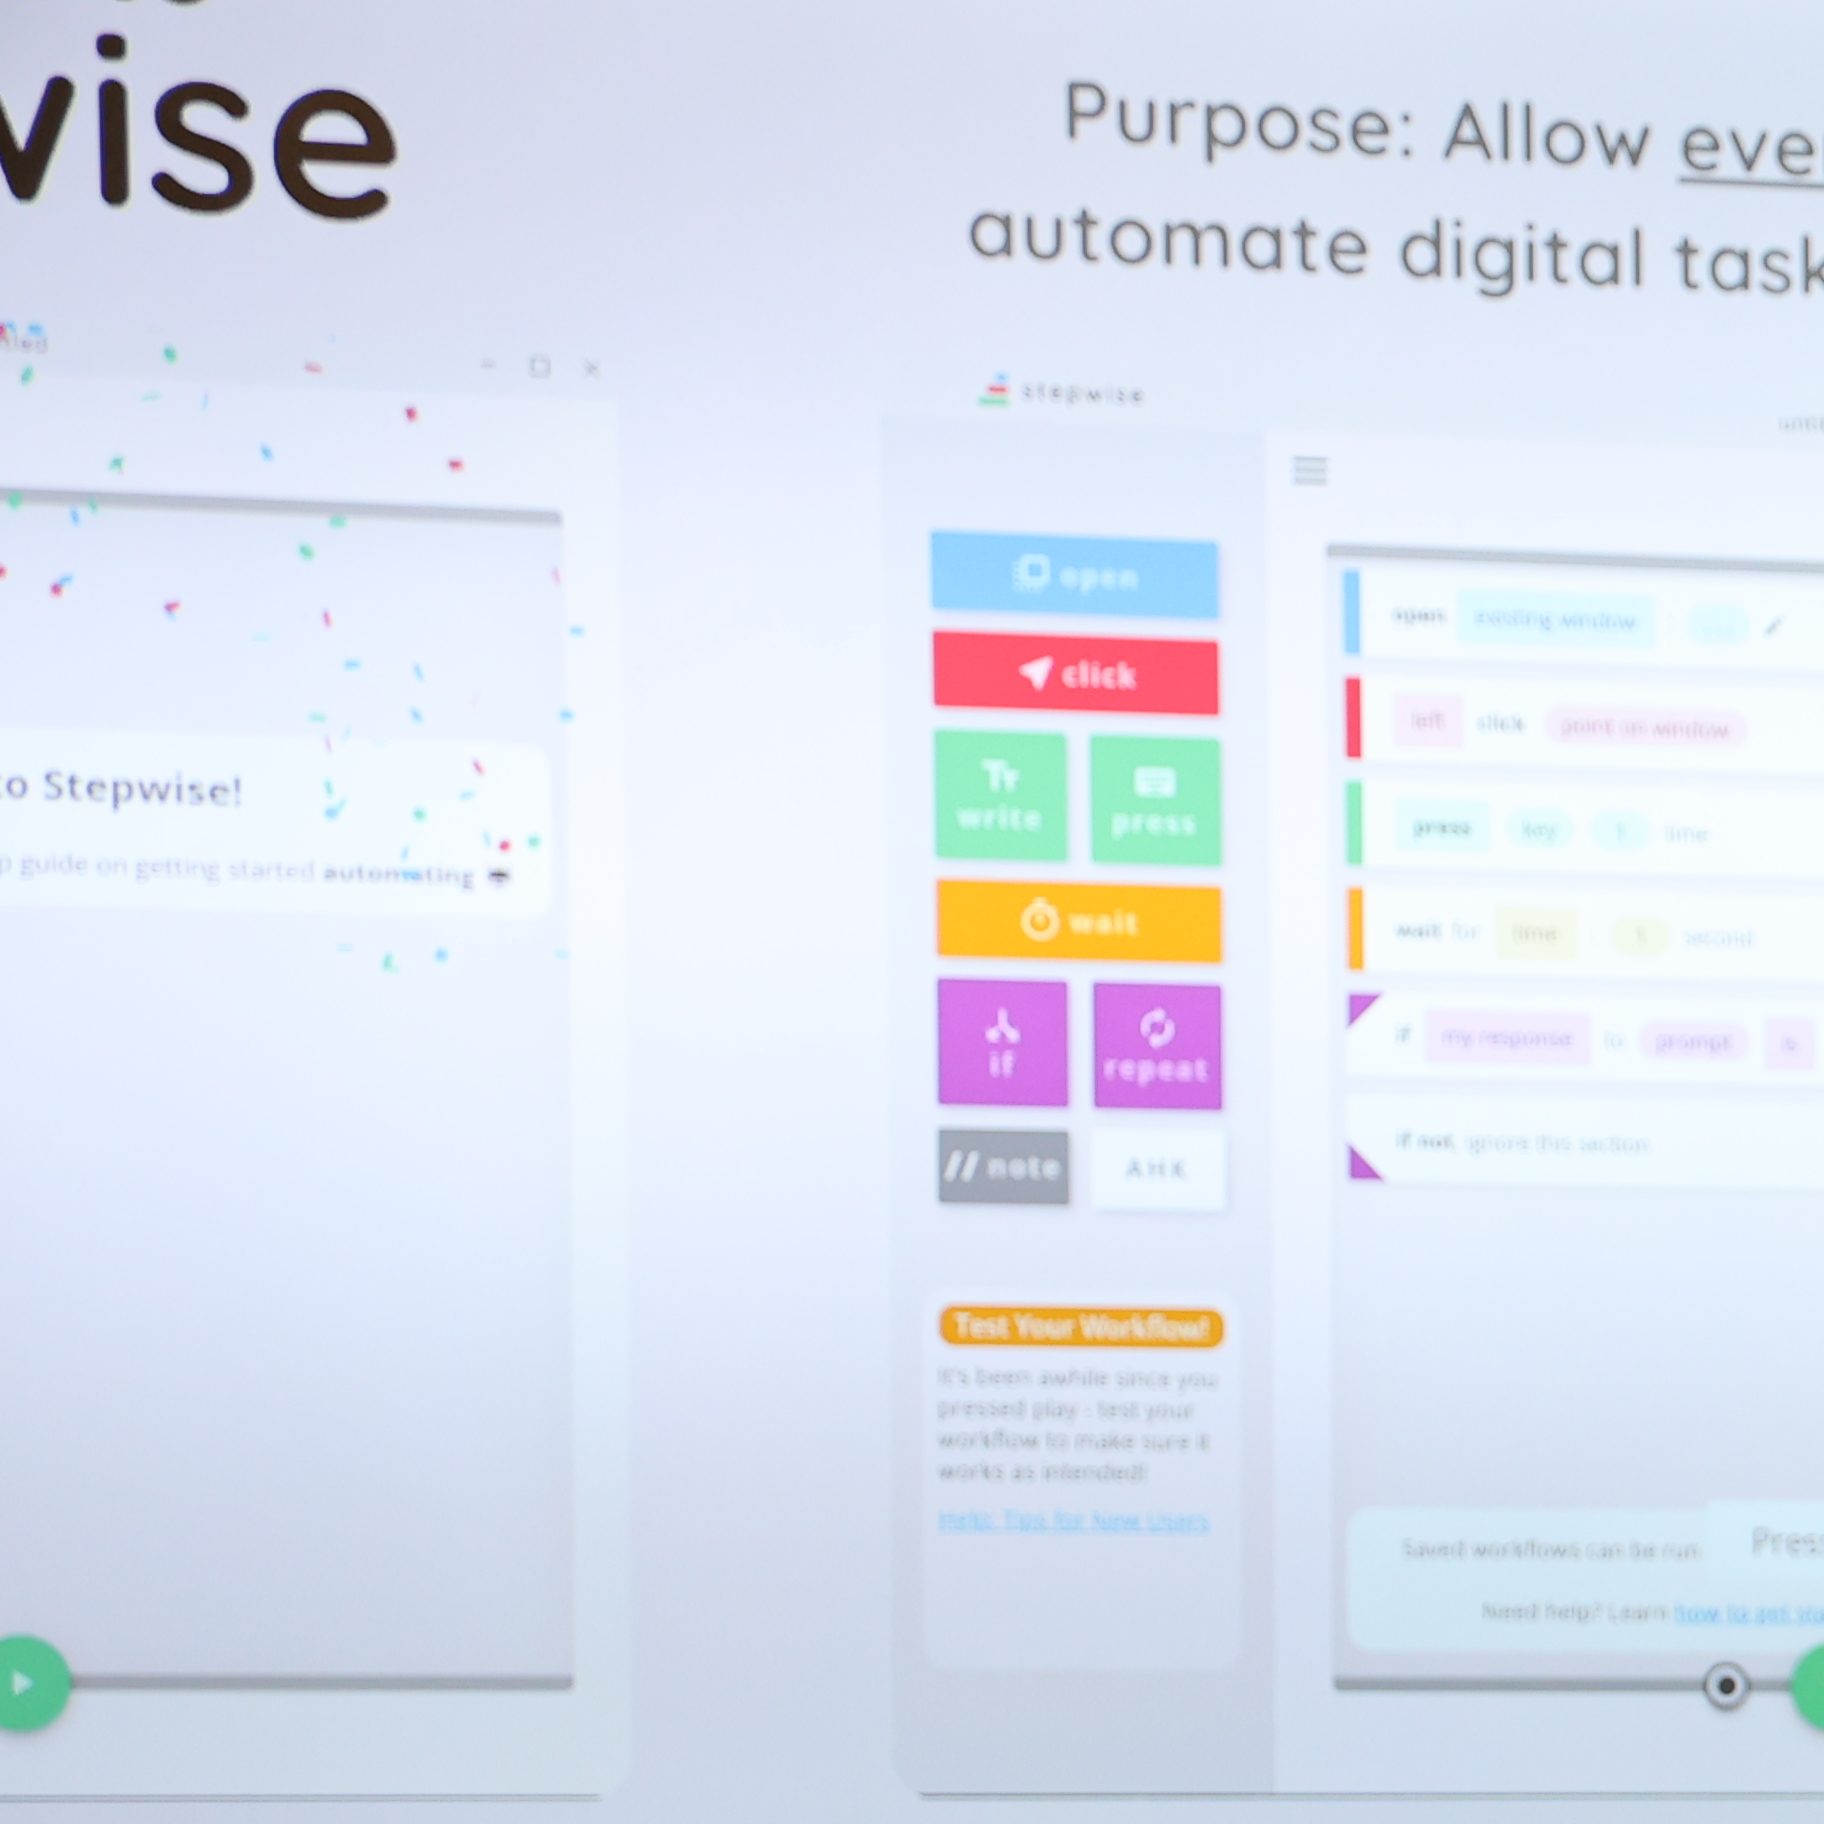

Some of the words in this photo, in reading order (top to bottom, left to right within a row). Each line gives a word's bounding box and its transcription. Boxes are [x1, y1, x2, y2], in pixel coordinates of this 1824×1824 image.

[1065, 81, 1414, 164] Purpose:
[1444, 102, 1652, 169] Allow
[970, 206, 1369, 275] automate
[1400, 217, 1643, 299] digital
[1022, 380, 1145, 408] stepwise
[1059, 566, 1139, 594] open
[1061, 660, 1138, 690] click
[1477, 711, 1526, 734] click
[44, 768, 242, 813] Stepwise!
[956, 805, 1043, 833] write
[1111, 811, 1198, 841] press
[20, 851, 88, 881] guide
[96, 857, 128, 876] on
[136, 856, 220, 886] getting
[228, 855, 314, 883] started
[323, 860, 474, 890] automating
[1068, 909, 1139, 938] wait
[989, 1050, 1015, 1079] if
[1103, 1057, 1209, 1088] repeat
[987, 1154, 1062, 1182] note
[1125, 1157, 1188, 1181] AHK
[955, 1311, 1009, 1340] Test
[1012, 1312, 1075, 1341] Your
[1078, 1312, 1210, 1342] Workflow!
